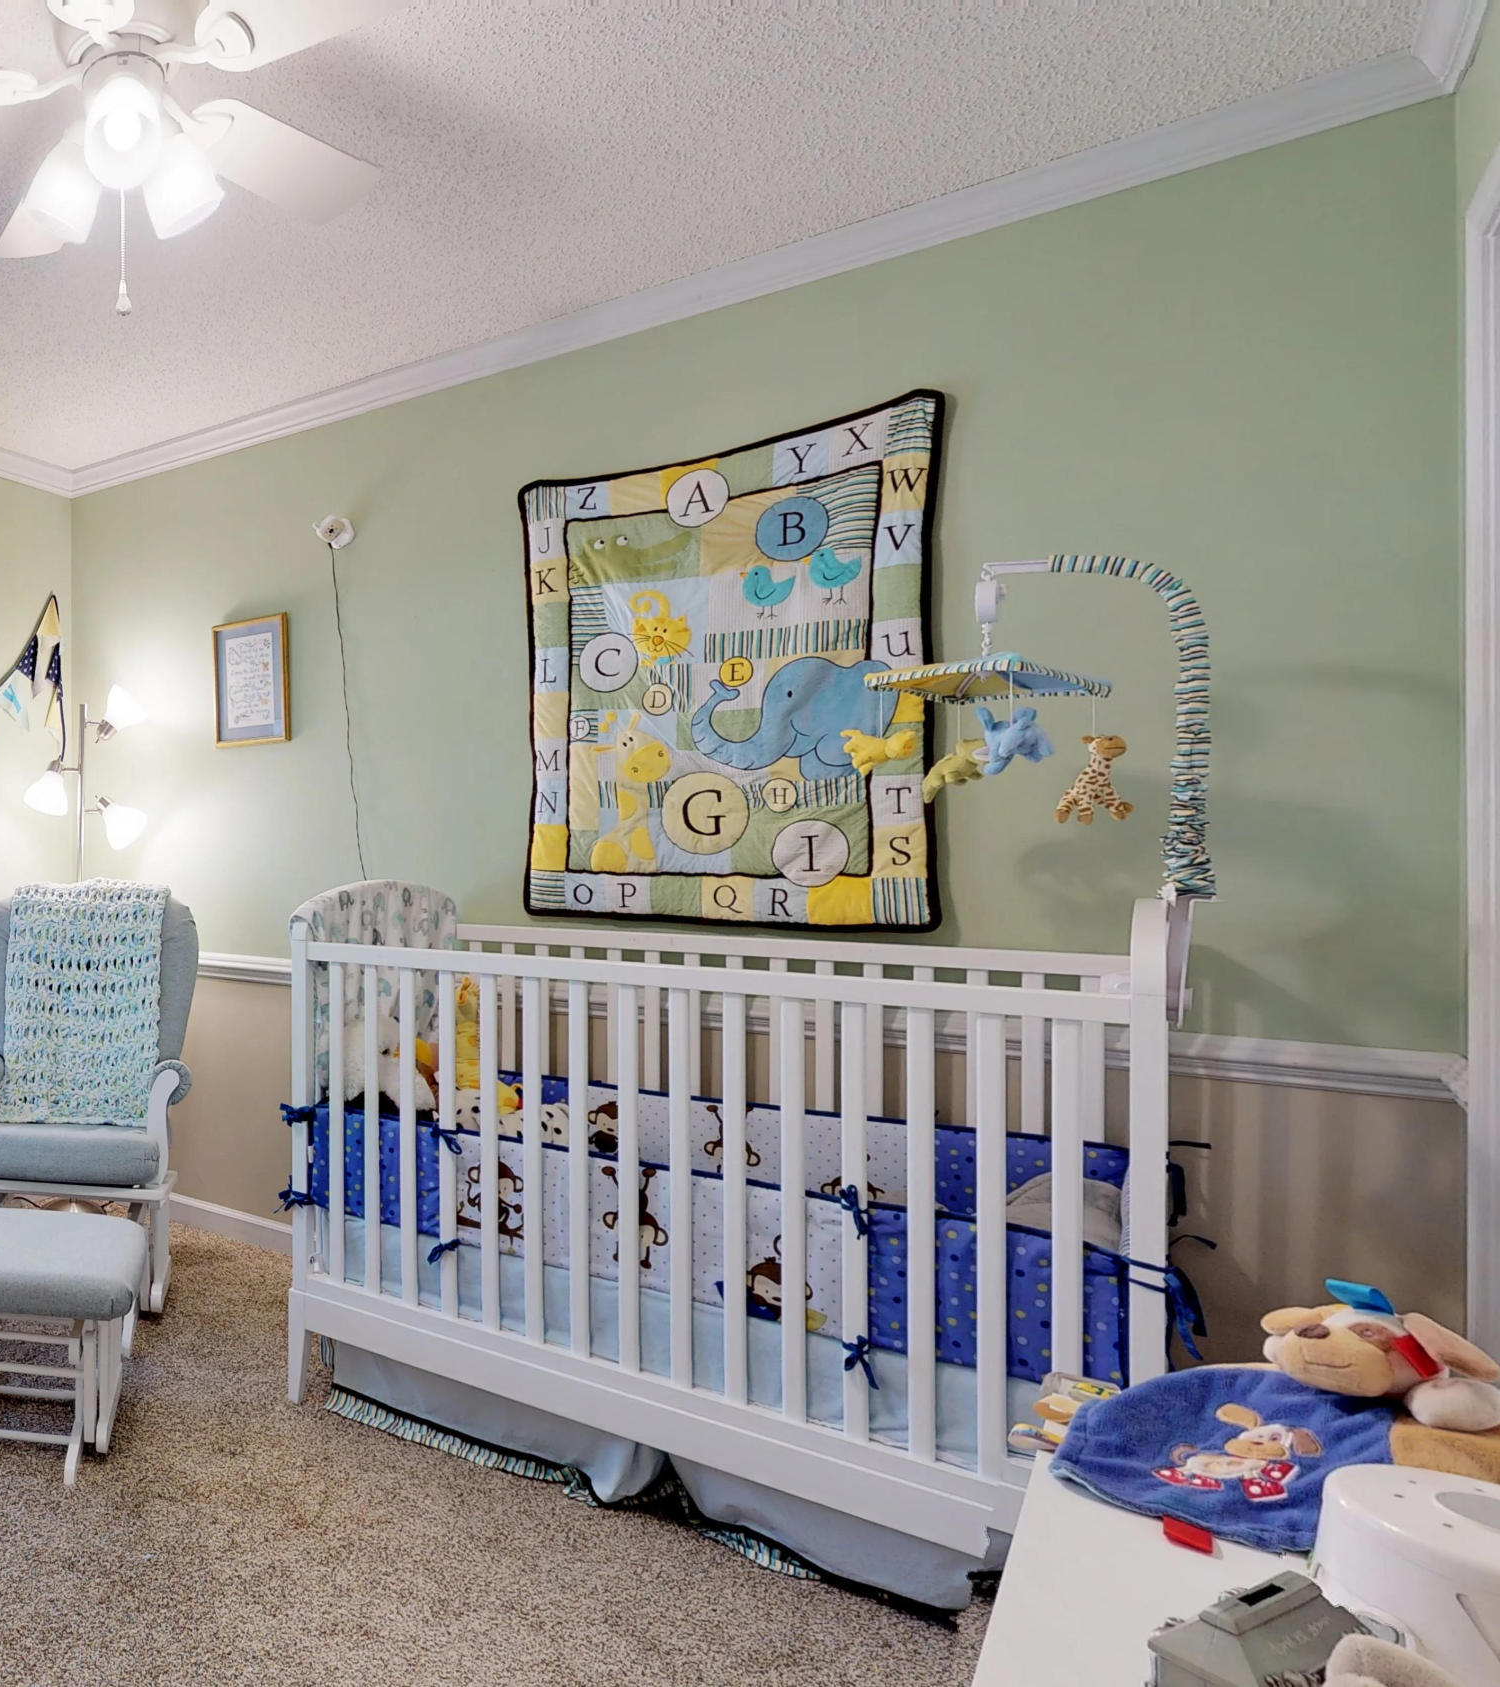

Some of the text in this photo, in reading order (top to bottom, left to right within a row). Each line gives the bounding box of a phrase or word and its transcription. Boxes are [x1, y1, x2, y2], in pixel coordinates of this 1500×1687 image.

[844, 421, 873, 456] X
[790, 444, 815, 474] Y
[887, 468, 928, 494] W
[577, 485, 597, 511] Z
[682, 482, 713, 516] A
[539, 527, 549, 553] J
[778, 512, 805, 546] B
[885, 524, 914, 550] V
[536, 567, 558, 595] K
[540, 659, 556, 683] L
[595, 649, 620, 676] C
[730, 663, 744, 681] E
[650, 691, 666, 708] D
[574, 720, 587, 737] F
[537, 750, 561, 773] M
[537, 791, 558, 813] N
[772, 788, 788, 804] H
[886, 786, 911, 814] T
[682, 789, 726, 837] G
[801, 835, 820, 871] I
[890, 837, 911, 866] S
[573, 883, 792, 917] O P Q R
